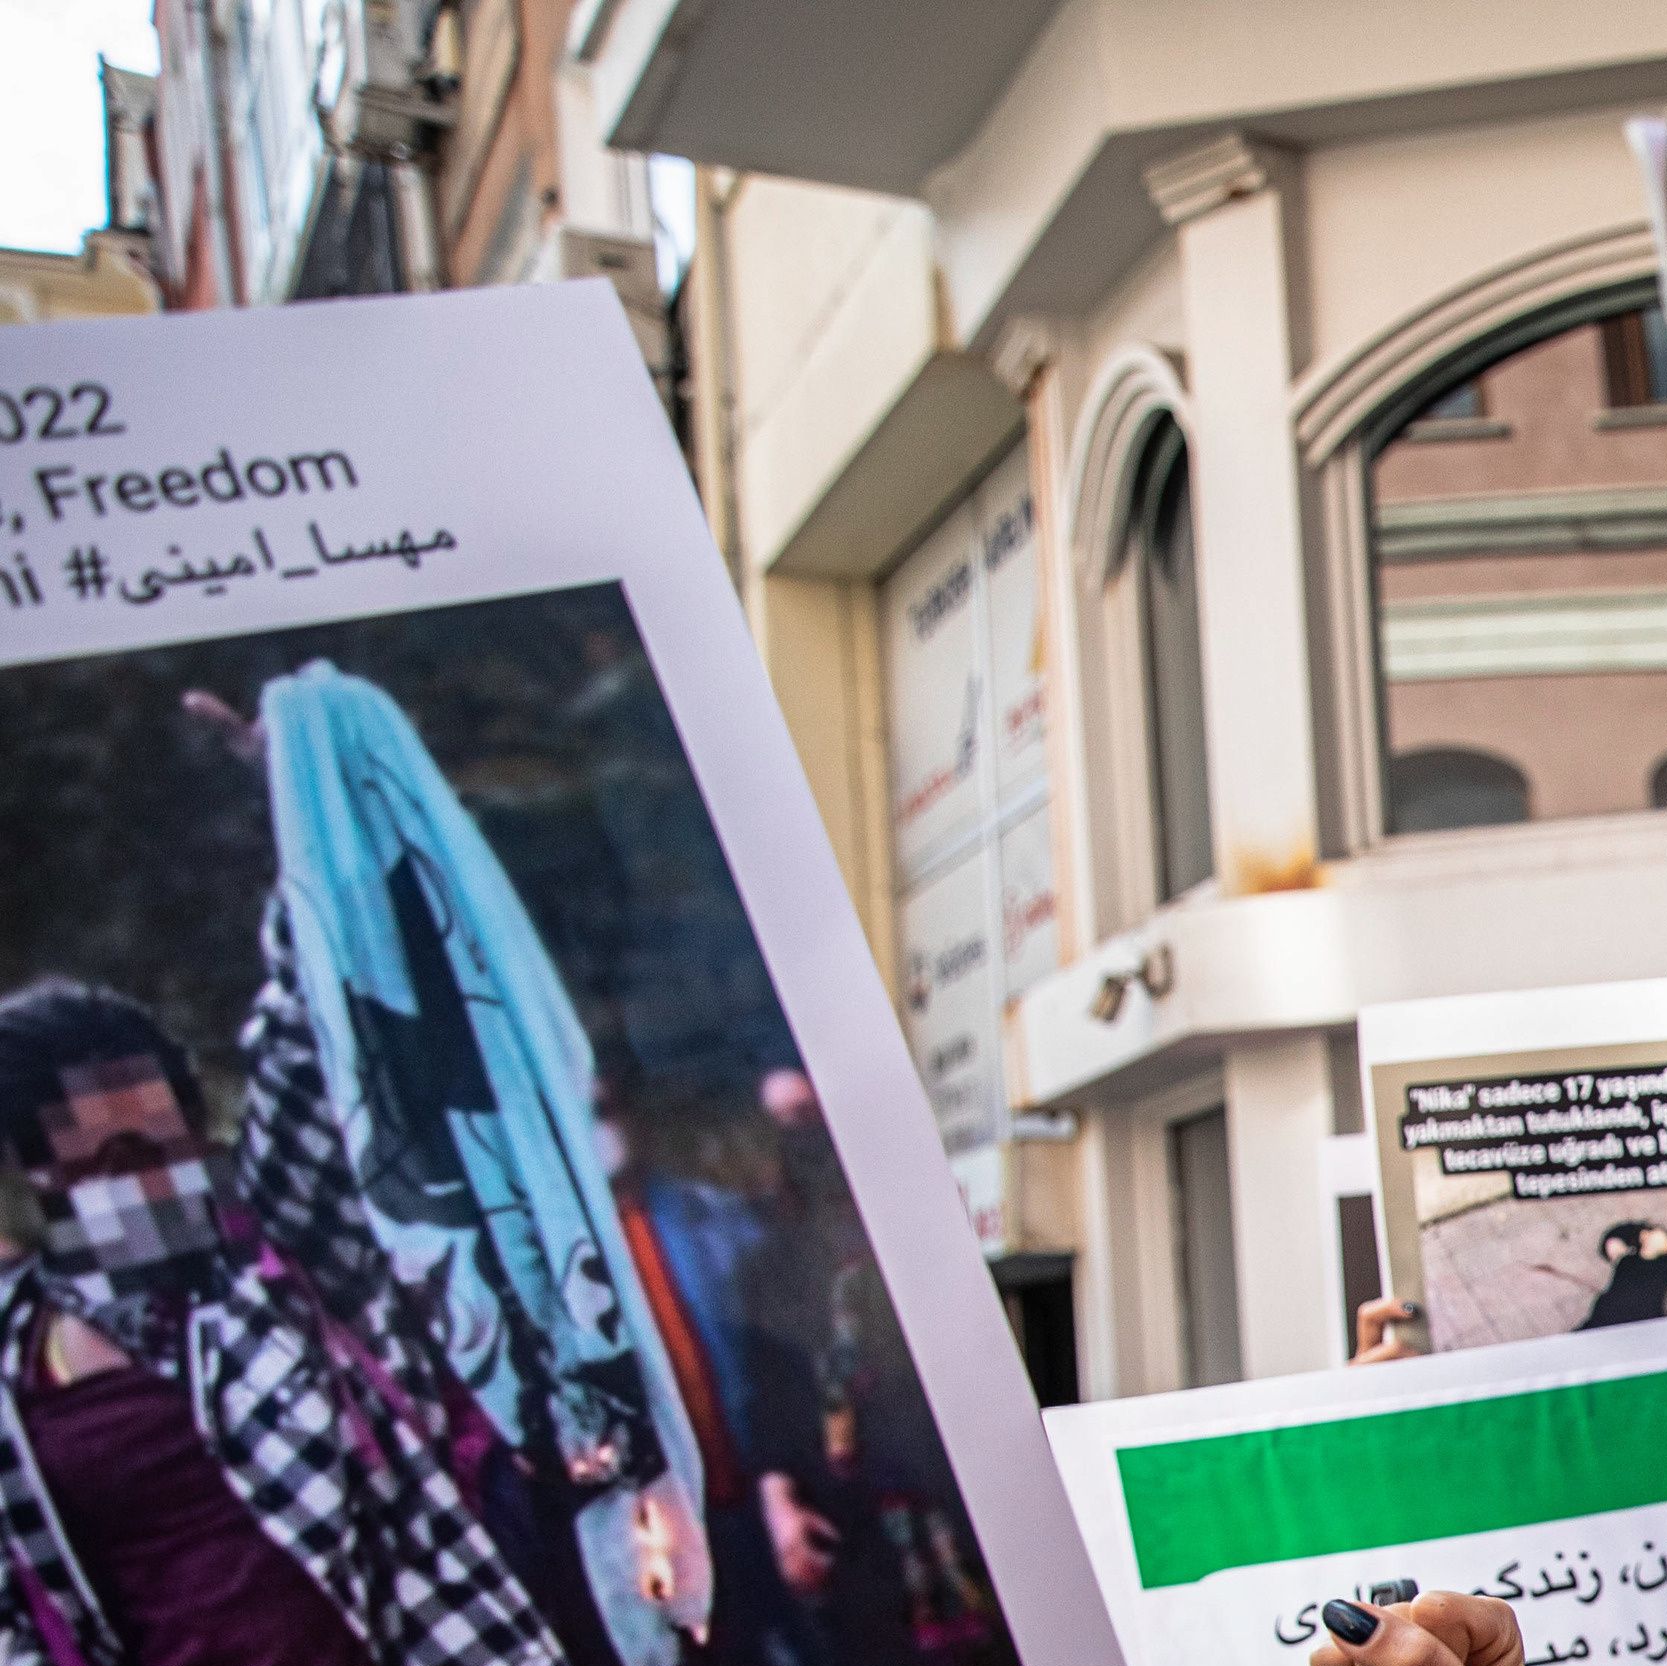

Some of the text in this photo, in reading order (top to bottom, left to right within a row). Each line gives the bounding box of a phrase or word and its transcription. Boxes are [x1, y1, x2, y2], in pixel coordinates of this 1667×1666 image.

[34, 447, 361, 522] Freedom
[1477, 1079, 1561, 1109] sadece
[1561, 1073, 1595, 1101] 17
[1624, 1134, 1658, 1158] ve
